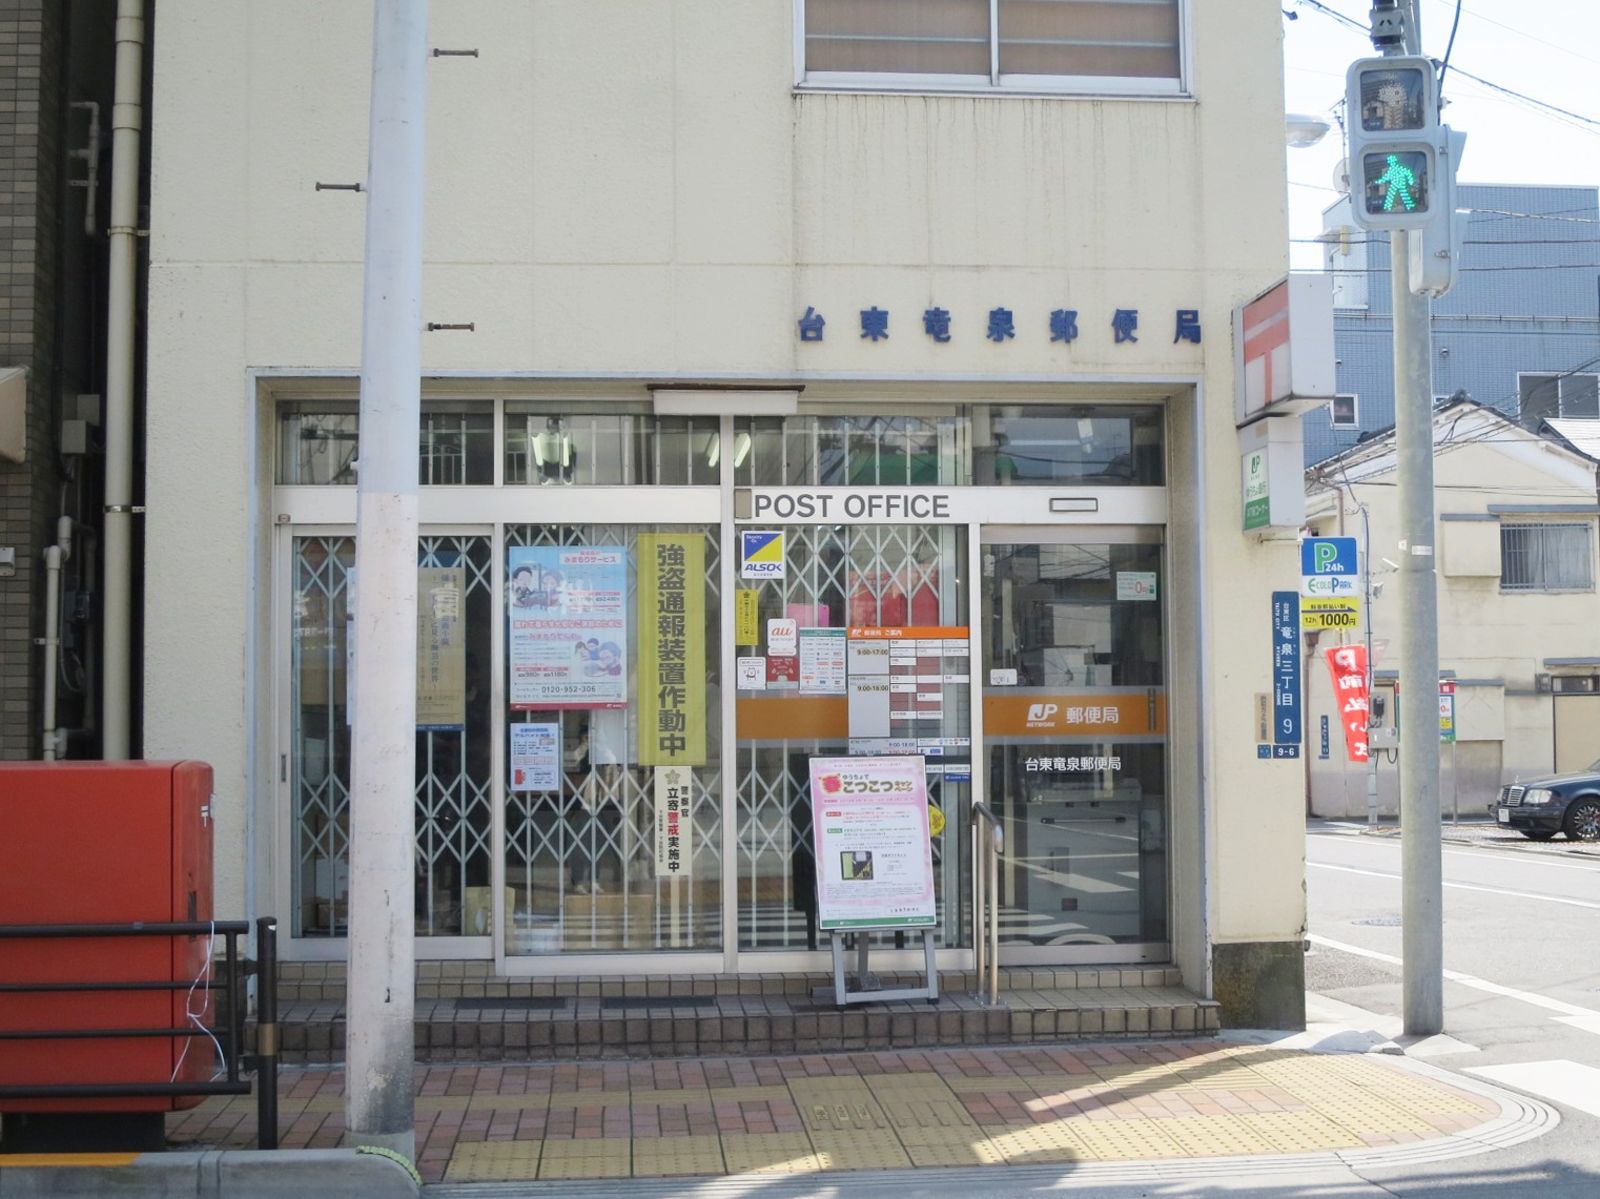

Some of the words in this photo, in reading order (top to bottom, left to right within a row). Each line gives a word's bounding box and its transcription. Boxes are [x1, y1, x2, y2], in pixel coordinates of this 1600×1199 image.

[798, 306, 1202, 345] 台東竜泉郵便局
[754, 495, 833, 518] POST
[844, 494, 950, 519] OFFICE
[1314, 542, 1338, 573] P
[745, 563, 782, 572] ALSOK
[1325, 563, 1344, 572] 24h
[1319, 613, 1356, 626] 1000円
[771, 627, 793, 637] au
[657, 544, 686, 757] 強盗通報装置作動中
[1281, 626, 1293, 707] 竜泉三丁目
[1066, 706, 1120, 724] 郵便局
[1283, 718, 1293, 735] 9
[1278, 745, 1295, 756] 9-6
[1025, 757, 1122, 772] 台東竜泉郵便局
[843, 780, 893, 794] こつこつ
[667, 788, 680, 873] 立寄警戒実施中
